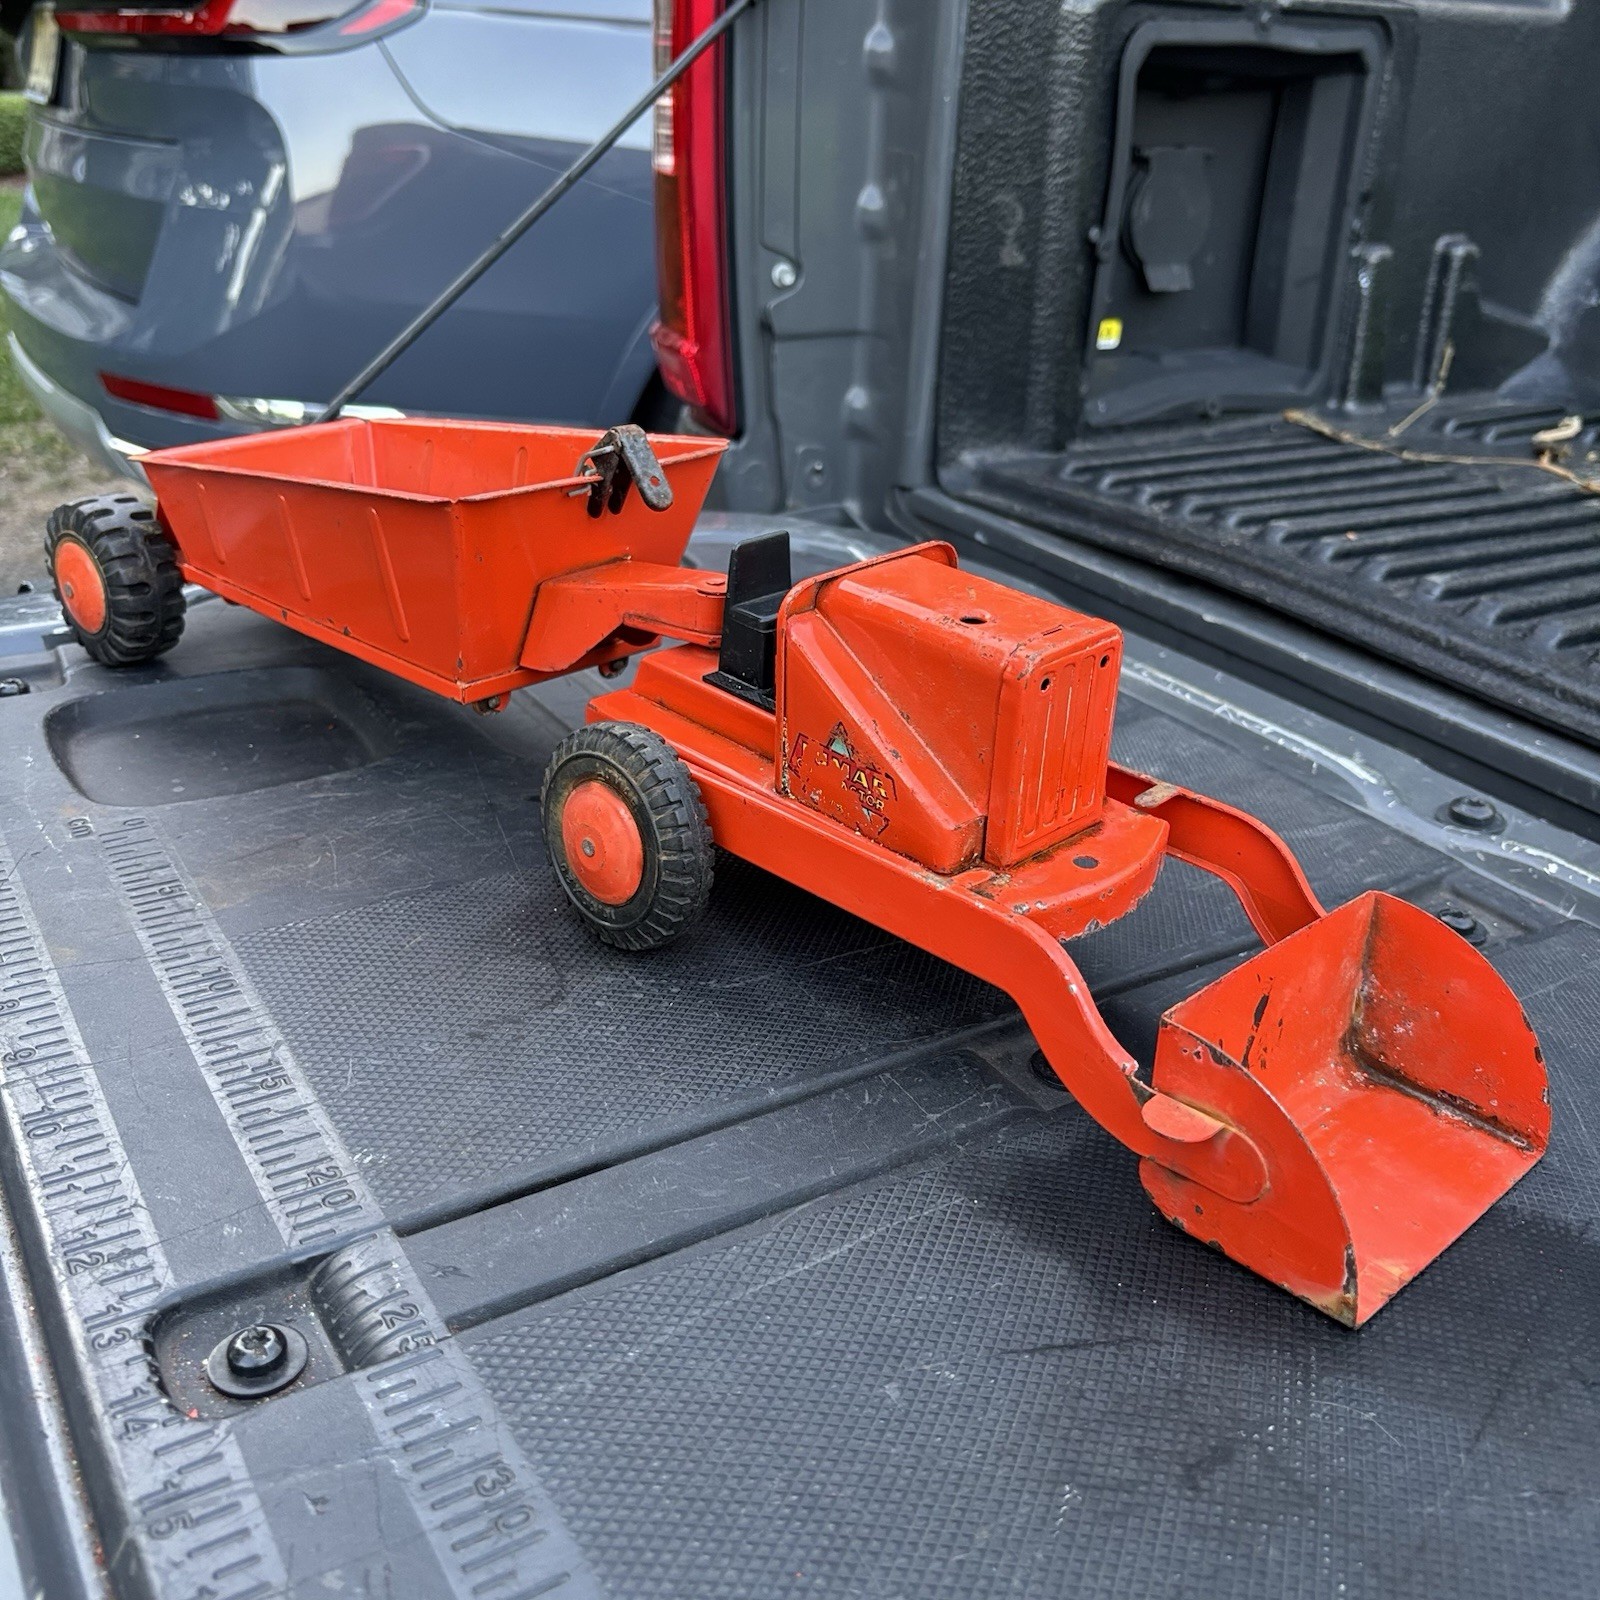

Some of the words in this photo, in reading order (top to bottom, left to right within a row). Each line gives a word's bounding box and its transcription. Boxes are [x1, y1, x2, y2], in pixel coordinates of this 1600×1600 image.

[202, 965, 239, 992] 10
[2, 1047, 37, 1062] 9
[251, 1058, 293, 1091] 15
[22, 1104, 63, 1139] 10
[40, 1164, 82, 1200] 11
[306, 1165, 357, 1208] 20
[61, 1230, 106, 1275] 12
[84, 1303, 132, 1351] 13
[380, 1302, 437, 1353] 25
[108, 1385, 159, 1441] 14
[132, 1479, 196, 1540] 15
[474, 1462, 535, 1534] 30
